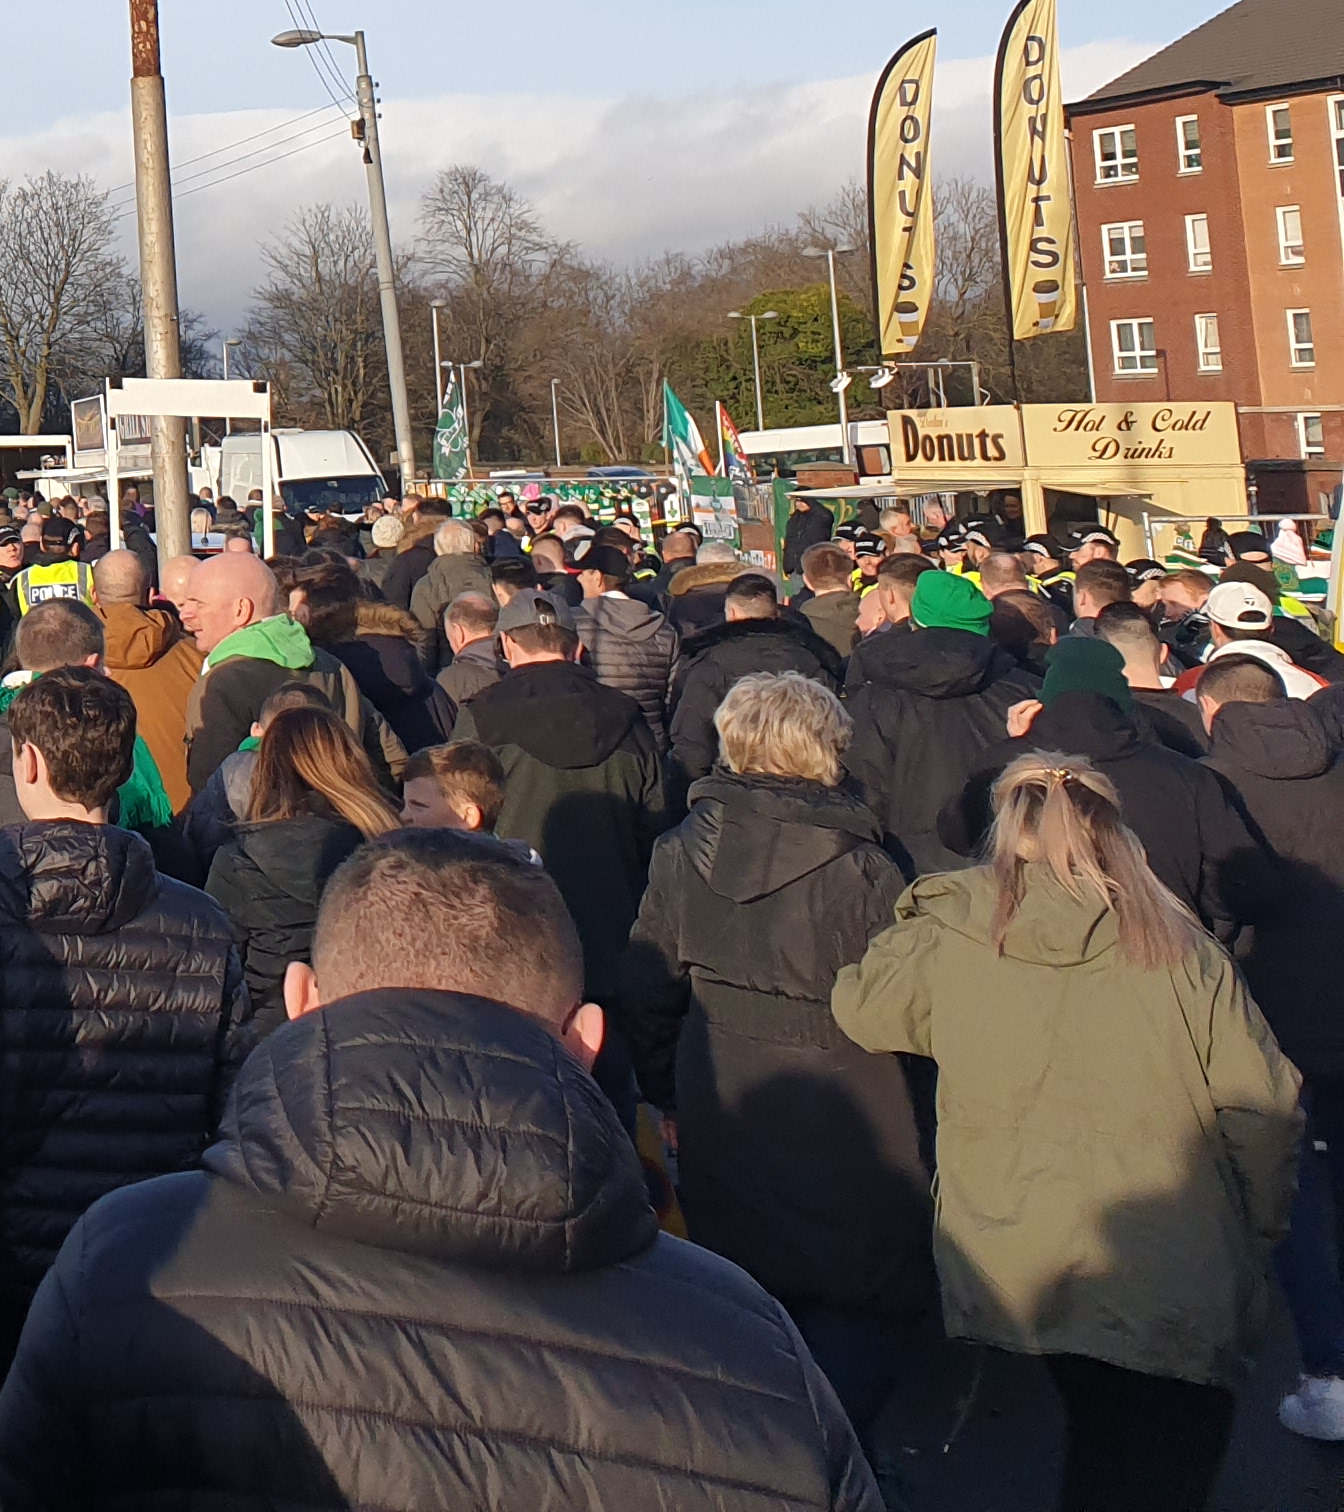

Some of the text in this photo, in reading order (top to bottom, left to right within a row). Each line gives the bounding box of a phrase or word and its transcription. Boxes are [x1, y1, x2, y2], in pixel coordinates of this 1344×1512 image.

[1022, 35, 1060, 269] DONUTS
[901, 414, 1007, 463] Donuts
[1053, 408, 1212, 434] Hot & Cold
[1087, 436, 1176, 462] Drinks
